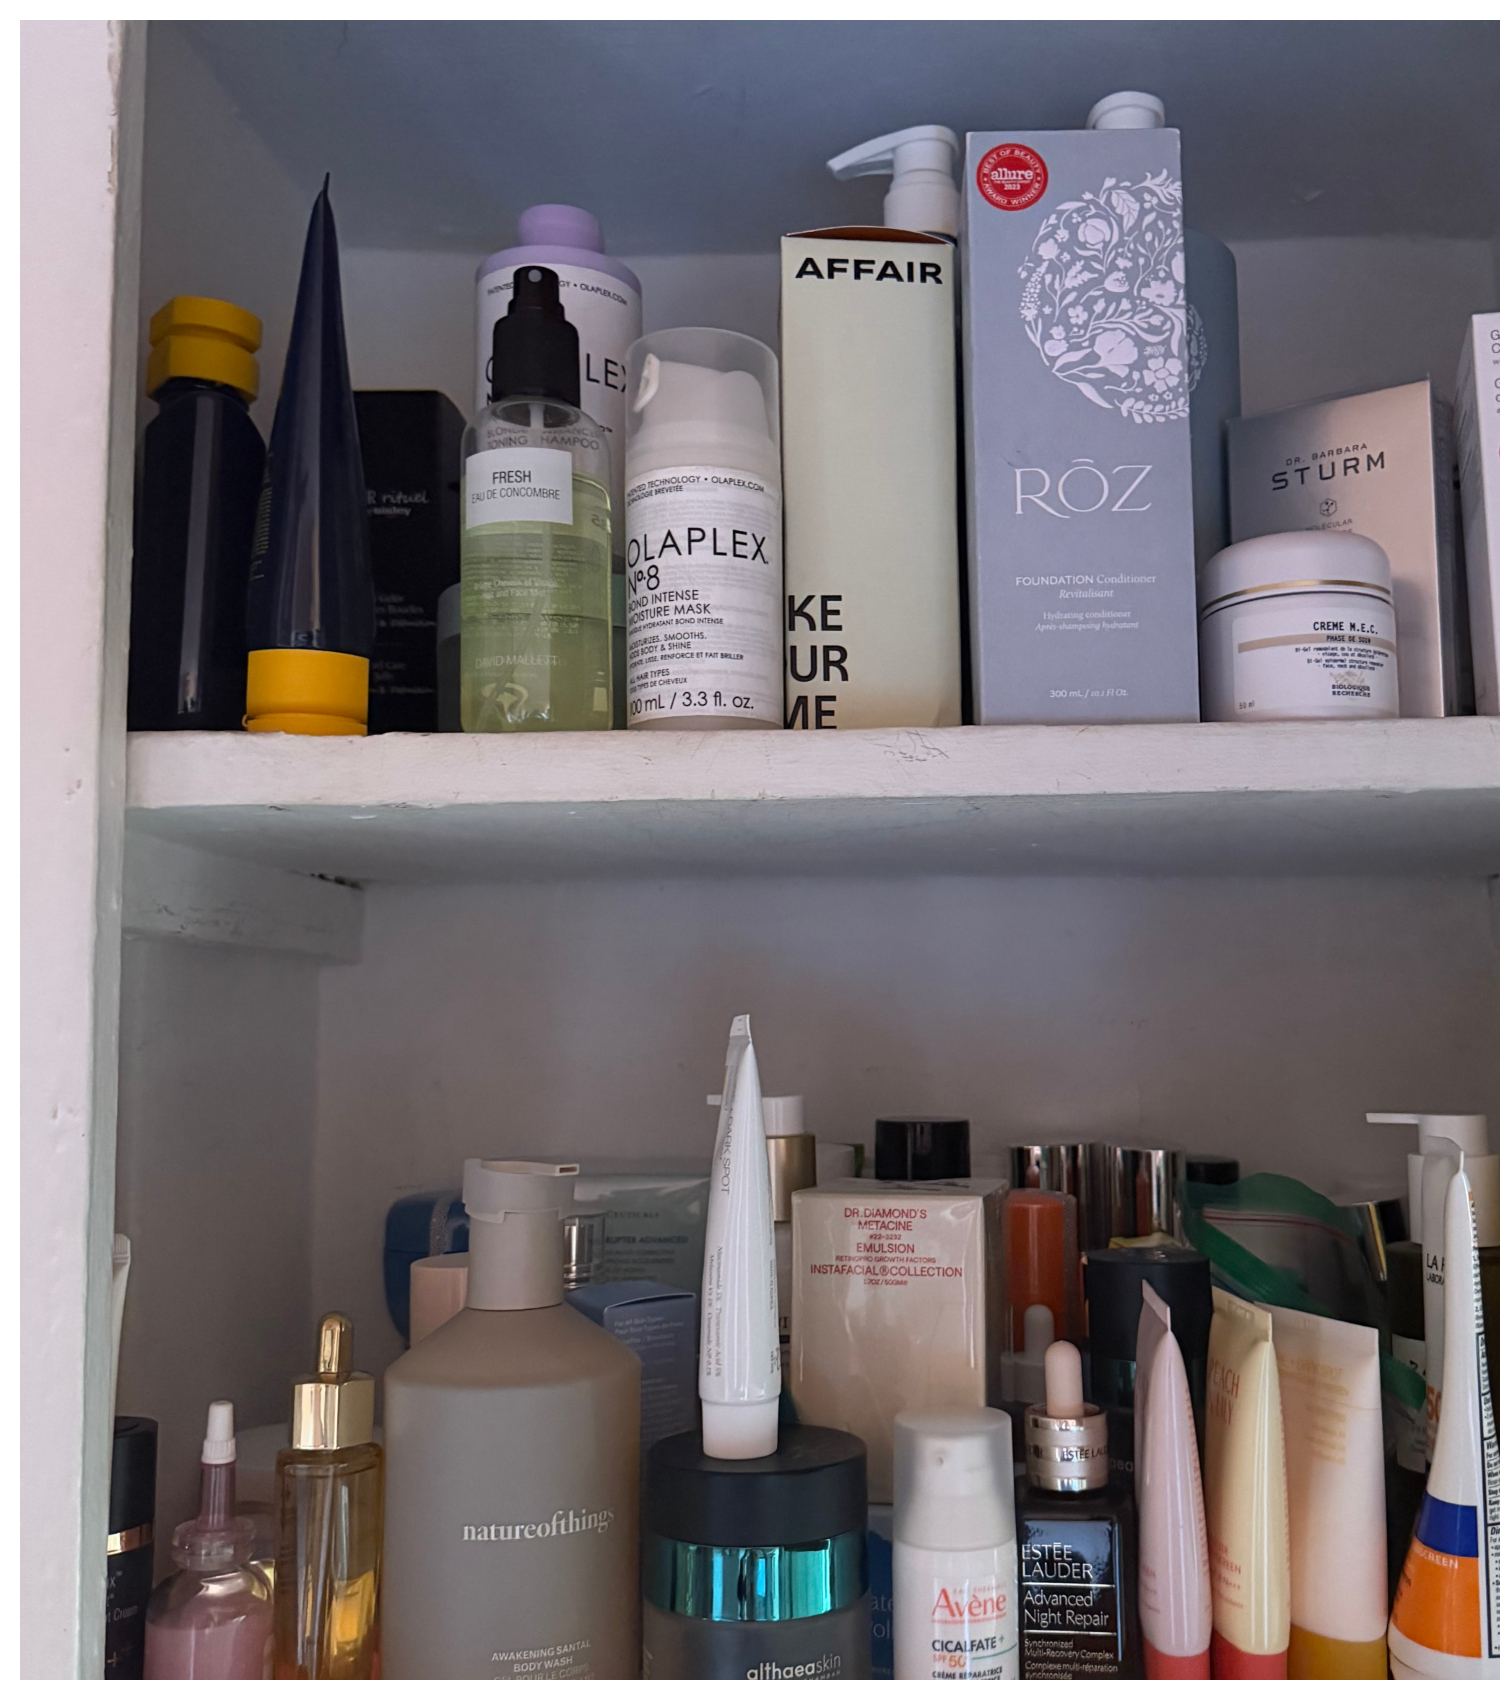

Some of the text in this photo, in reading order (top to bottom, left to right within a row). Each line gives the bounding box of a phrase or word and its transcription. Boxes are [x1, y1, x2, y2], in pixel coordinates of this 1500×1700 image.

[991, 167, 1034, 181] allure
[795, 257, 943, 285] AFFAIR
[1311, 443, 1368, 461] BARBARA
[492, 470, 532, 485] FRESH
[1271, 450, 1385, 492] STURM
[647, 475, 765, 493] TECHNOLOGY OLAPLEX.COM
[382, 490, 429, 505] rituel
[471, 486, 561, 504] EAU DE CONCOMBRE
[1015, 572, 1157, 587] FOUNDATION Conditioner
[651, 589, 699, 605] INTENSE
[1058, 588, 1114, 600] Revitalisant
[674, 603, 711, 616] MASK
[1043, 608, 1132, 621] Hydrating conditioner
[697, 617, 724, 625] INTENSE
[1313, 621, 1379, 635] CREME M.E.C.
[1348, 635, 1356, 643] DE
[640, 641, 692, 656] BODY & SHINE
[790, 645, 849, 683] UR
[650, 668, 670, 678] TYPES
[658, 677, 688, 685] CHEVEUX
[645, 694, 665, 711] mL
[669, 691, 677, 710] /
[682, 691, 708, 707] 3.3
[732, 695, 754, 710] oz.
[1049, 689, 1068, 698] 300
[1069, 689, 1084, 697] mL
[1331, 690, 1371, 698] RECHERCHE
[721, 1157, 731, 1196] SPOT
[857, 1220, 913, 1232] METACINE
[856, 1242, 916, 1254] EMULSION
[874, 1255, 905, 1264] GROWTH
[906, 1255, 937, 1265] FACTORS
[1426, 1253, 1439, 1271] LA
[462, 1508, 616, 1541] natureofthings
[1022, 1561, 1094, 1580] LAUDER
[932, 1587, 1007, 1618] Avène
[1023, 1589, 1094, 1608] Advanced
[1024, 1608, 1062, 1628] Night
[1066, 1609, 1110, 1629] Repair
[491, 1639, 592, 1662] AWAKENING SANTAL
[1024, 1638, 1074, 1650] Synchronized
[1024, 1648, 1115, 1660] Multi-Recovery Complex
[513, 1656, 574, 1673] BODY WASH
[1024, 1660, 1062, 1672] Complexe
